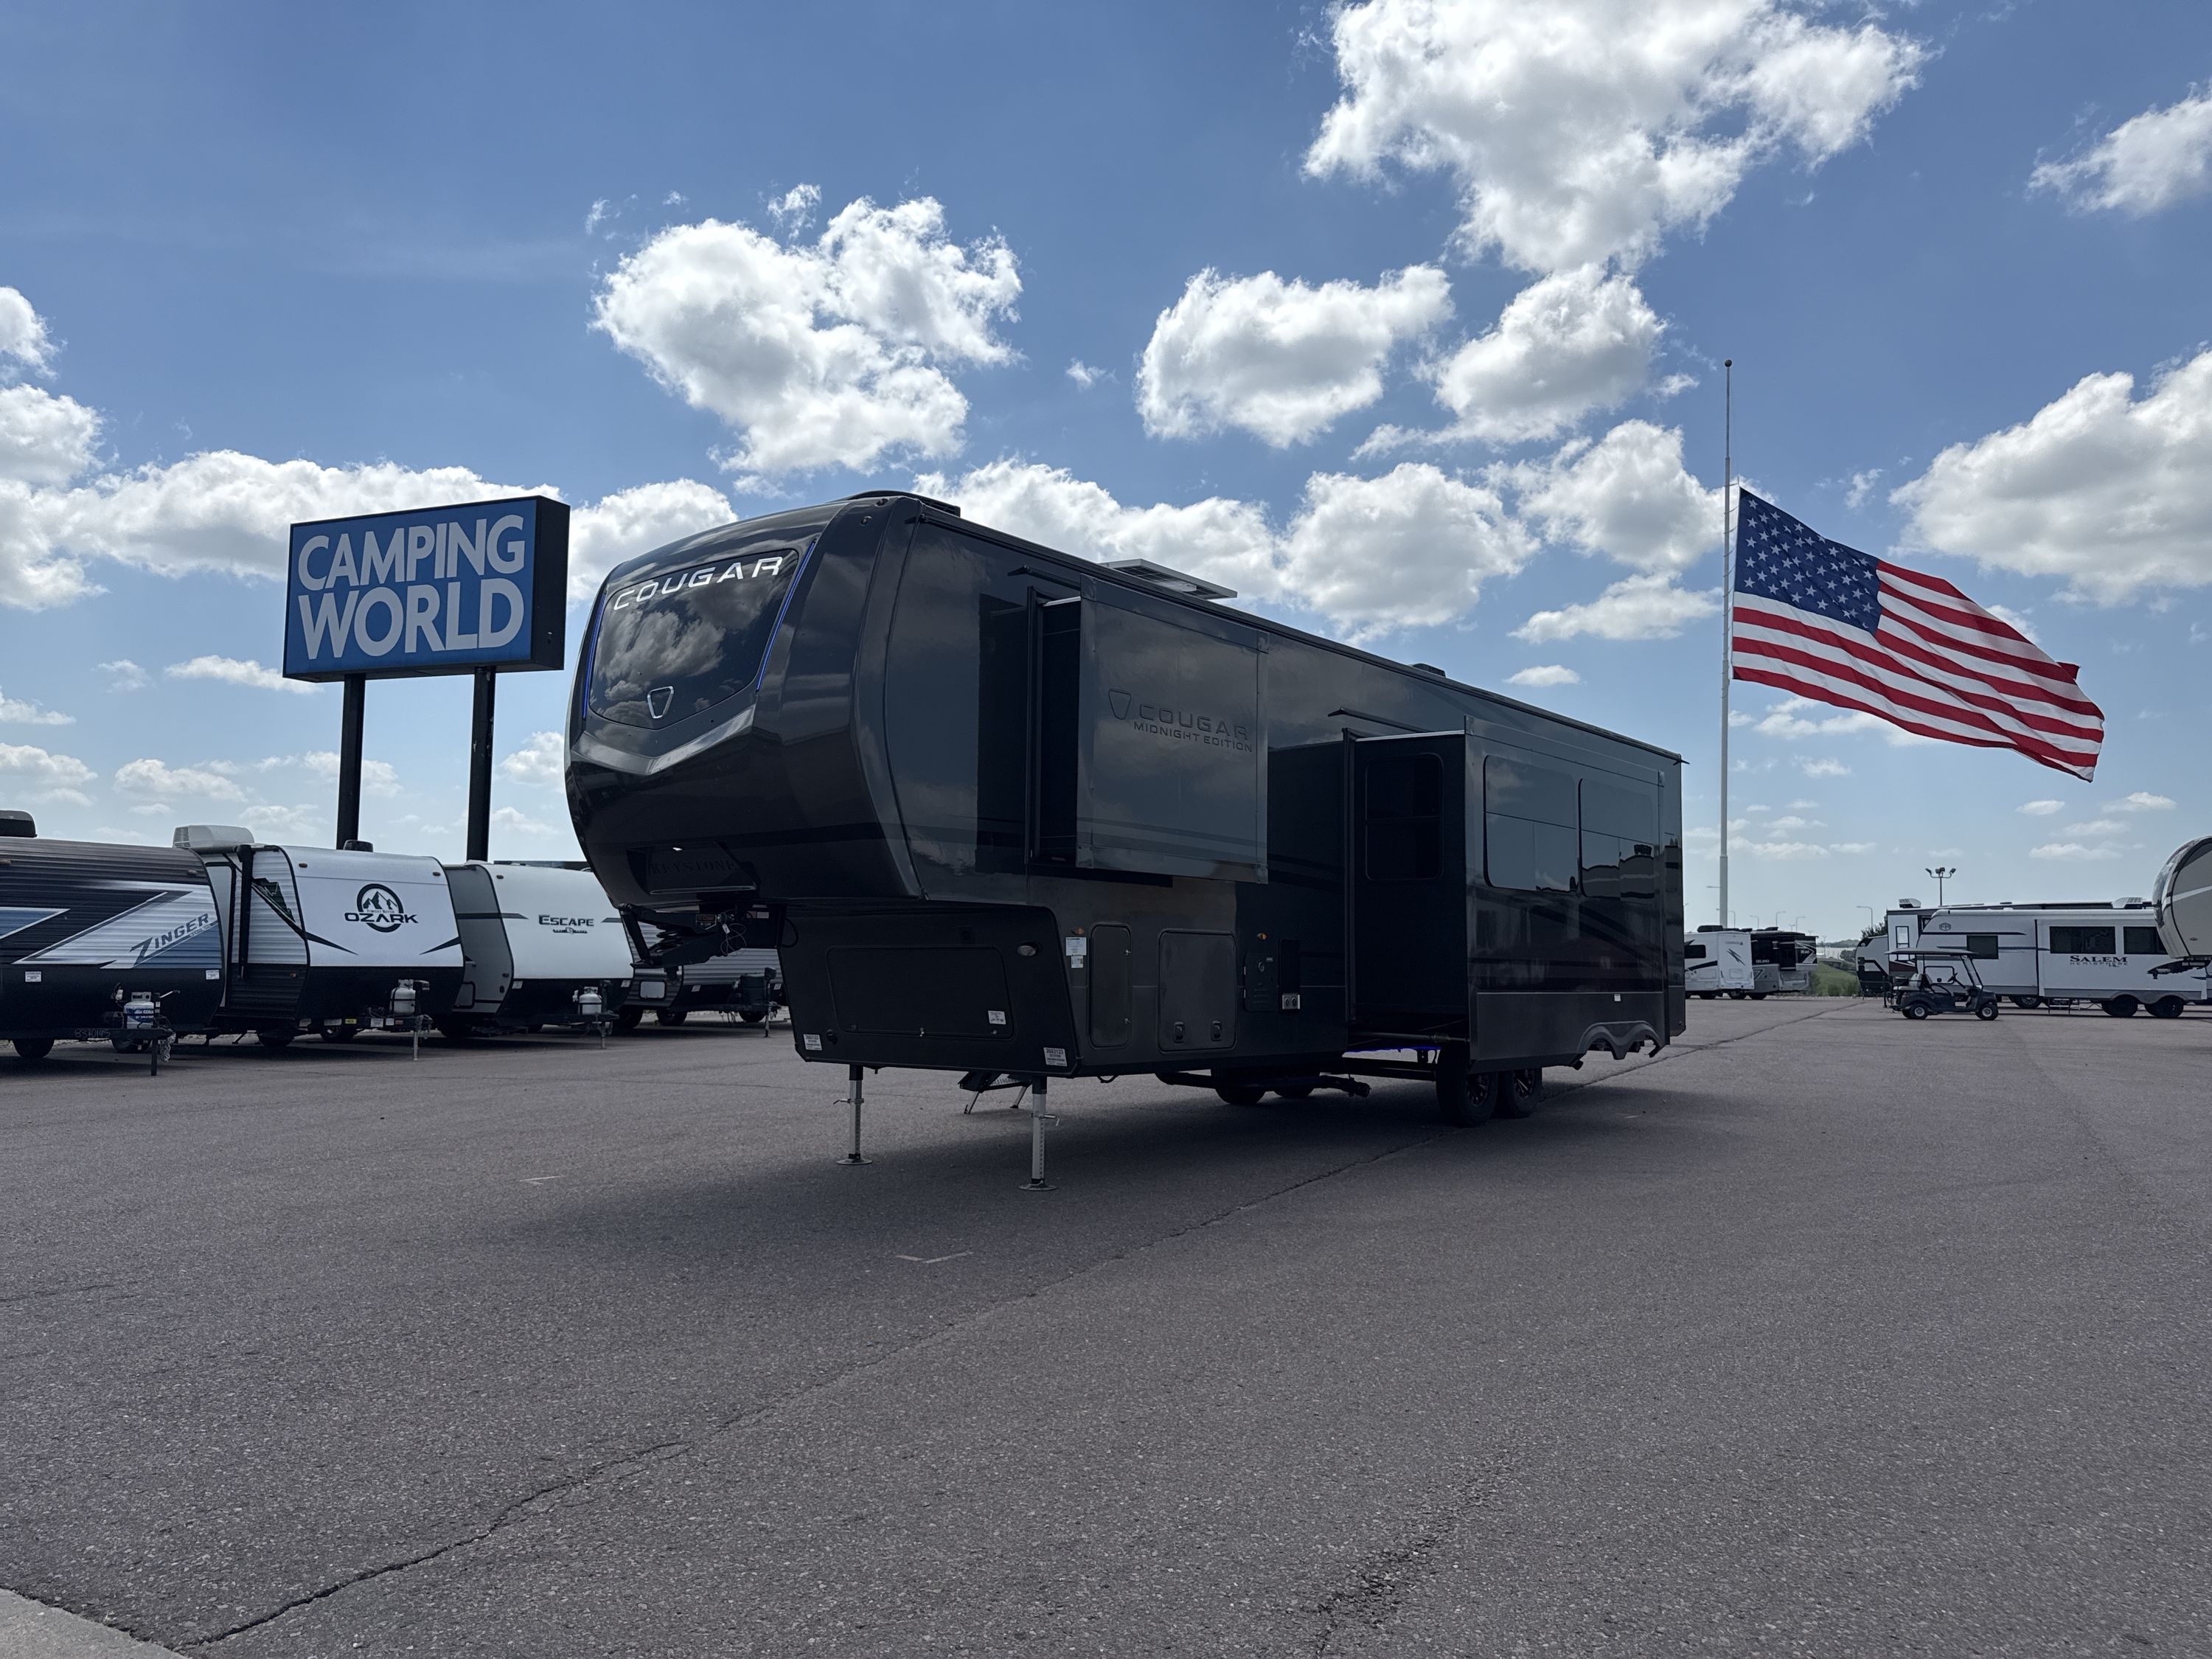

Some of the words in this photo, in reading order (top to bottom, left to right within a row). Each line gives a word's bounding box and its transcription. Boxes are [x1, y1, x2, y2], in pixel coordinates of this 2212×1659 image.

[298, 515, 525, 591] CAMPING
[613, 556, 785, 610] COUGAR
[298, 578, 524, 660] WORLD
[1134, 721, 1200, 742] MIDNIGHT
[1203, 735, 1253, 753] EDITION
[1139, 703, 1248, 740] COUGAR
[130, 914, 209, 966] ZINGER
[344, 913, 419, 923] OZARK
